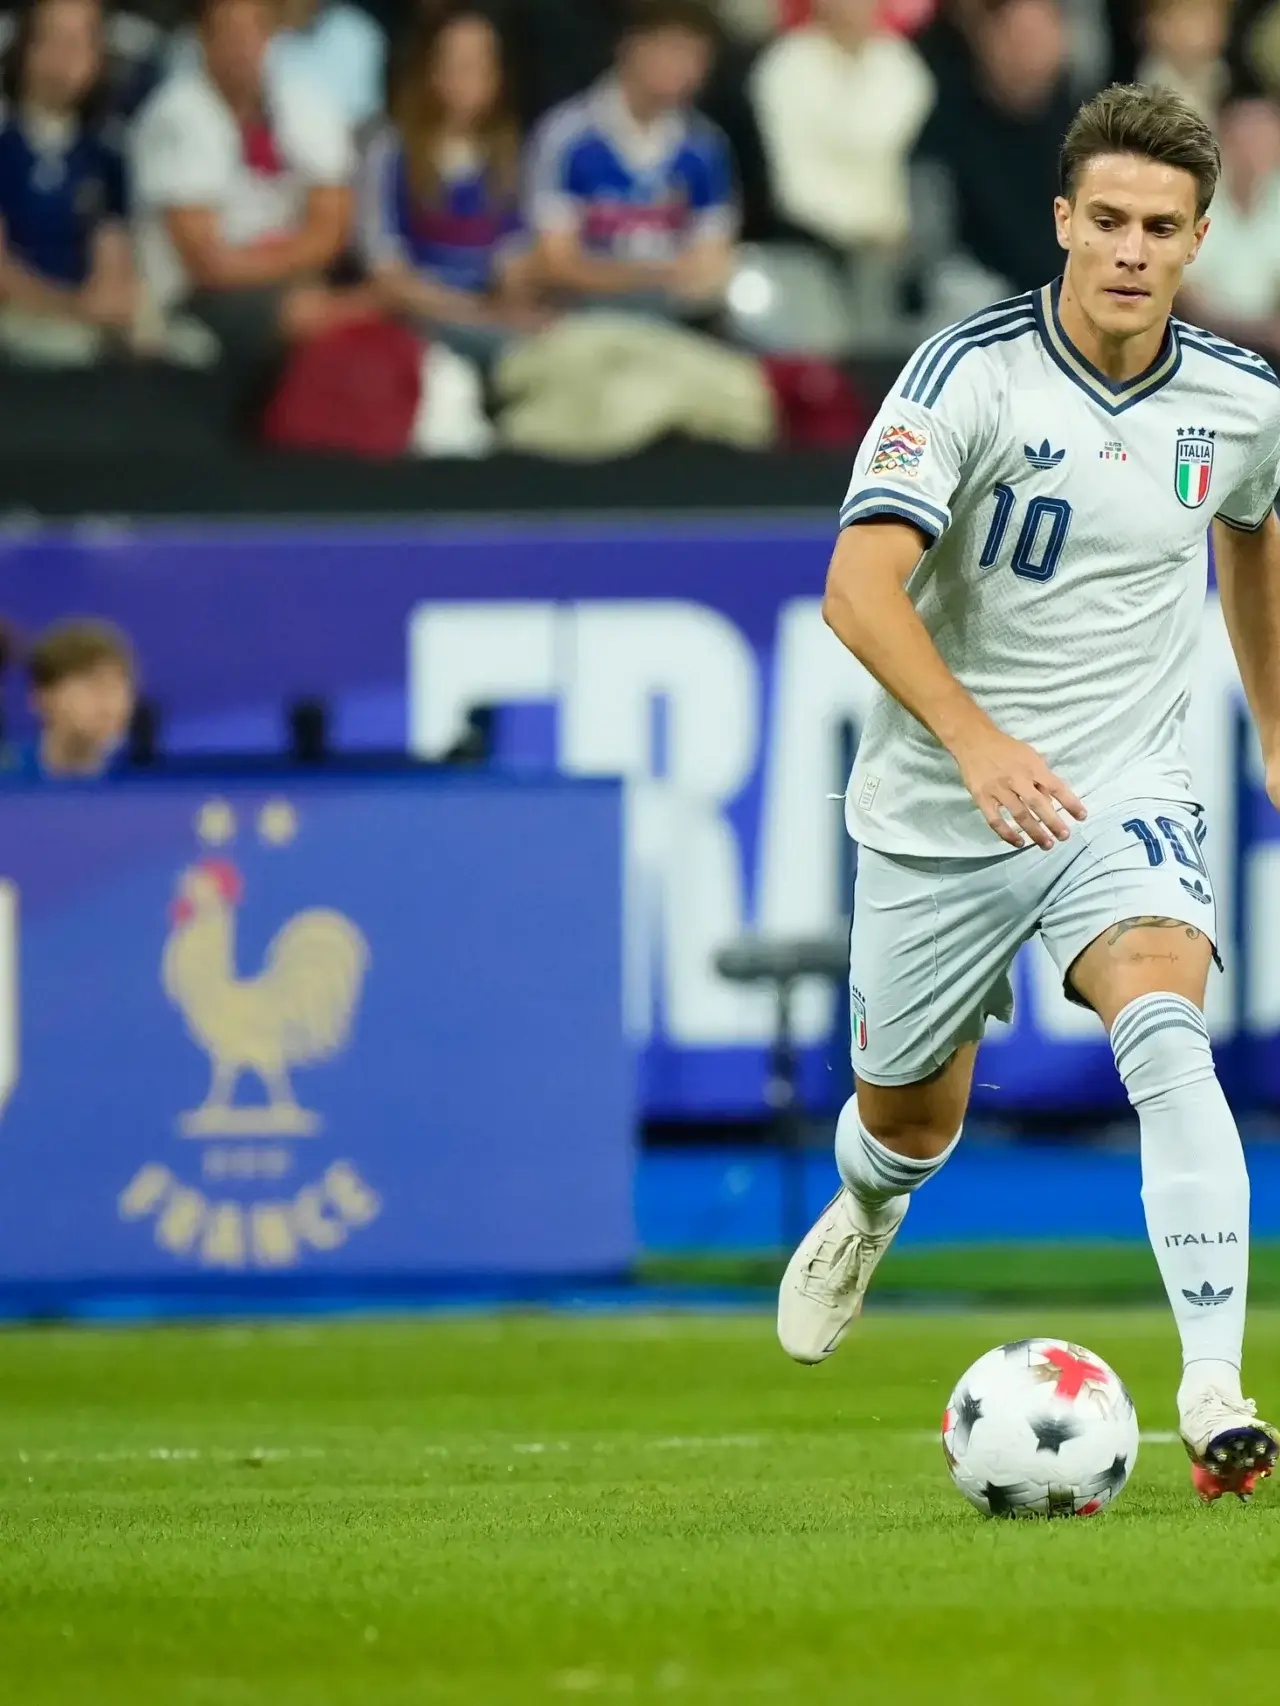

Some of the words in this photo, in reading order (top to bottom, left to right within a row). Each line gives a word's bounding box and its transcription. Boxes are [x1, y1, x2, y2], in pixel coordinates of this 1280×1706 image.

[1180, 444, 1210, 458] ITALIA
[979, 482, 1073, 584] 10
[1121, 816, 1208, 880] 10
[1165, 1232, 1238, 1248] ITALIA
